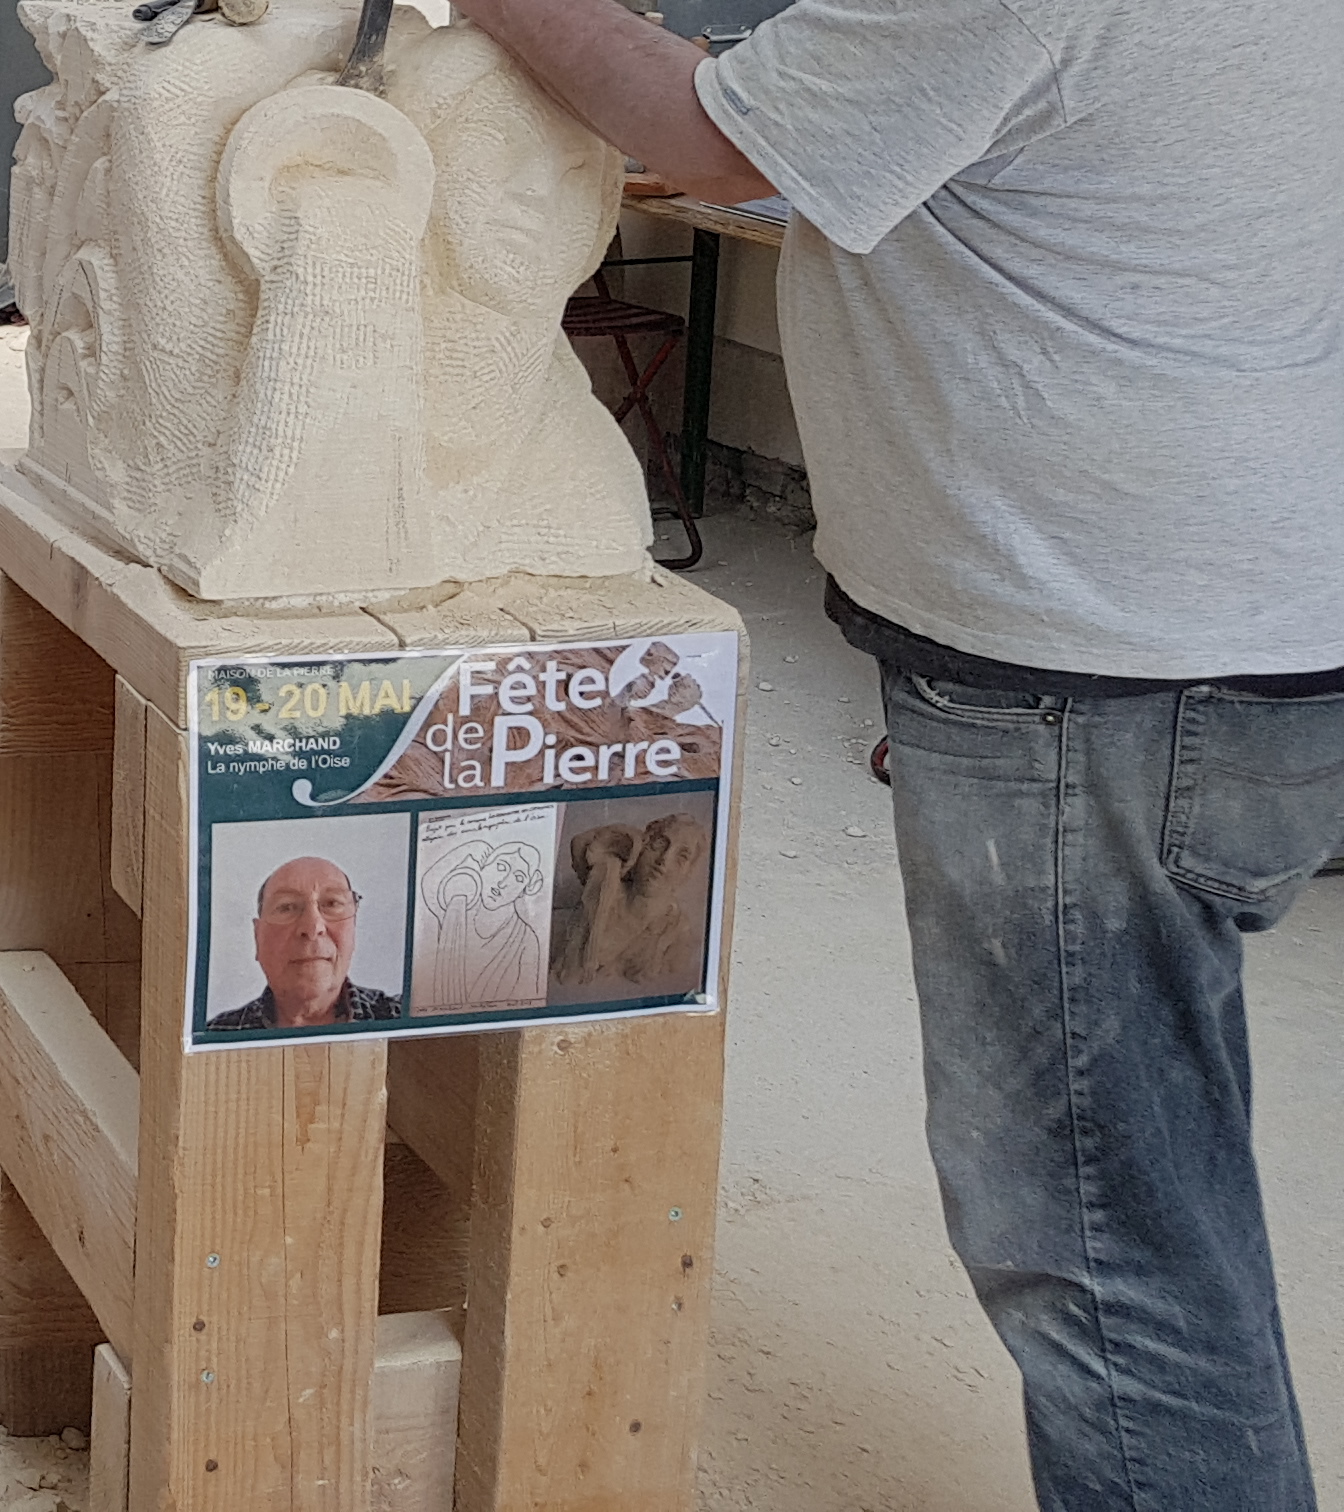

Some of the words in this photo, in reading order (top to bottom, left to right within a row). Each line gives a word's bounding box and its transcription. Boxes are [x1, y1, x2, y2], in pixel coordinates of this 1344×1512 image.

[207, 667, 254, 680] MAISON
[257, 668, 274, 678] DE
[276, 667, 291, 677] LA
[293, 665, 335, 677] PIERRE
[458, 656, 606, 717] Fête
[204, 686, 249, 722] 19
[278, 682, 328, 720] 20
[338, 679, 412, 717] MAI
[207, 741, 244, 756] Yves
[248, 737, 341, 754] MARCHAND
[425, 713, 485, 752] de
[490, 714, 682, 788] Pierre
[207, 761, 226, 774] La
[229, 757, 286, 777] nymphe
[289, 756, 307, 770] de
[311, 754, 351, 769] l'Oise
[442, 750, 485, 790] la
